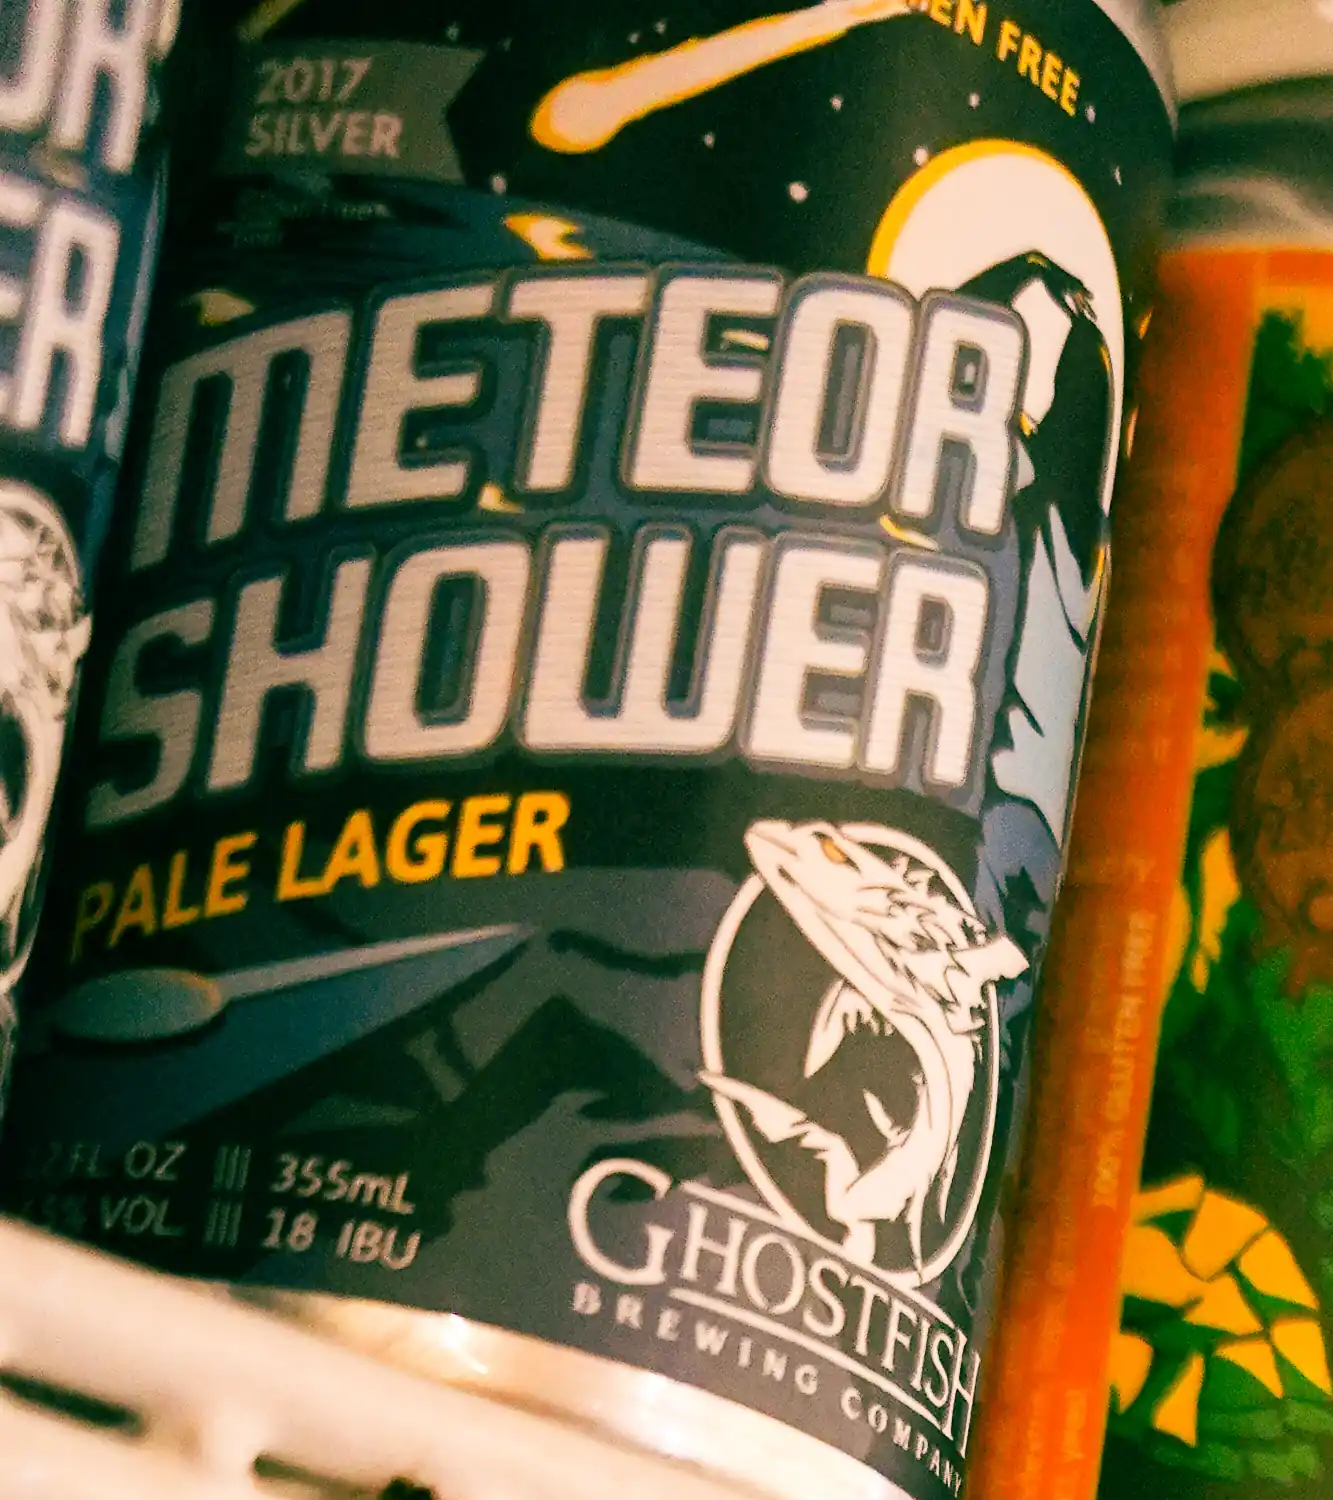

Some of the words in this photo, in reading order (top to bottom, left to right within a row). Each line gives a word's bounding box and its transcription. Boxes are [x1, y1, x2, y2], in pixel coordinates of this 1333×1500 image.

[246, 110, 404, 158] SILVER
[257, 57, 371, 104] 2017
[998, 20, 1080, 117] FREE
[129, 270, 1024, 570] METEOR
[85, 530, 988, 826] SHOWER
[71, 833, 257, 962] PALE
[276, 791, 571, 902] LAGER
[101, 1197, 184, 1238] VOL
[262, 1208, 319, 1253] 18
[335, 1219, 422, 1271] IBU
[123, 1140, 188, 1182] OZ
[271, 1153, 417, 1216] 355mL
[568, 1157, 982, 1458] GHOSTFISH
[573, 1282, 819, 1396] BREWING
[841, 1388, 965, 1499] COMPANY
